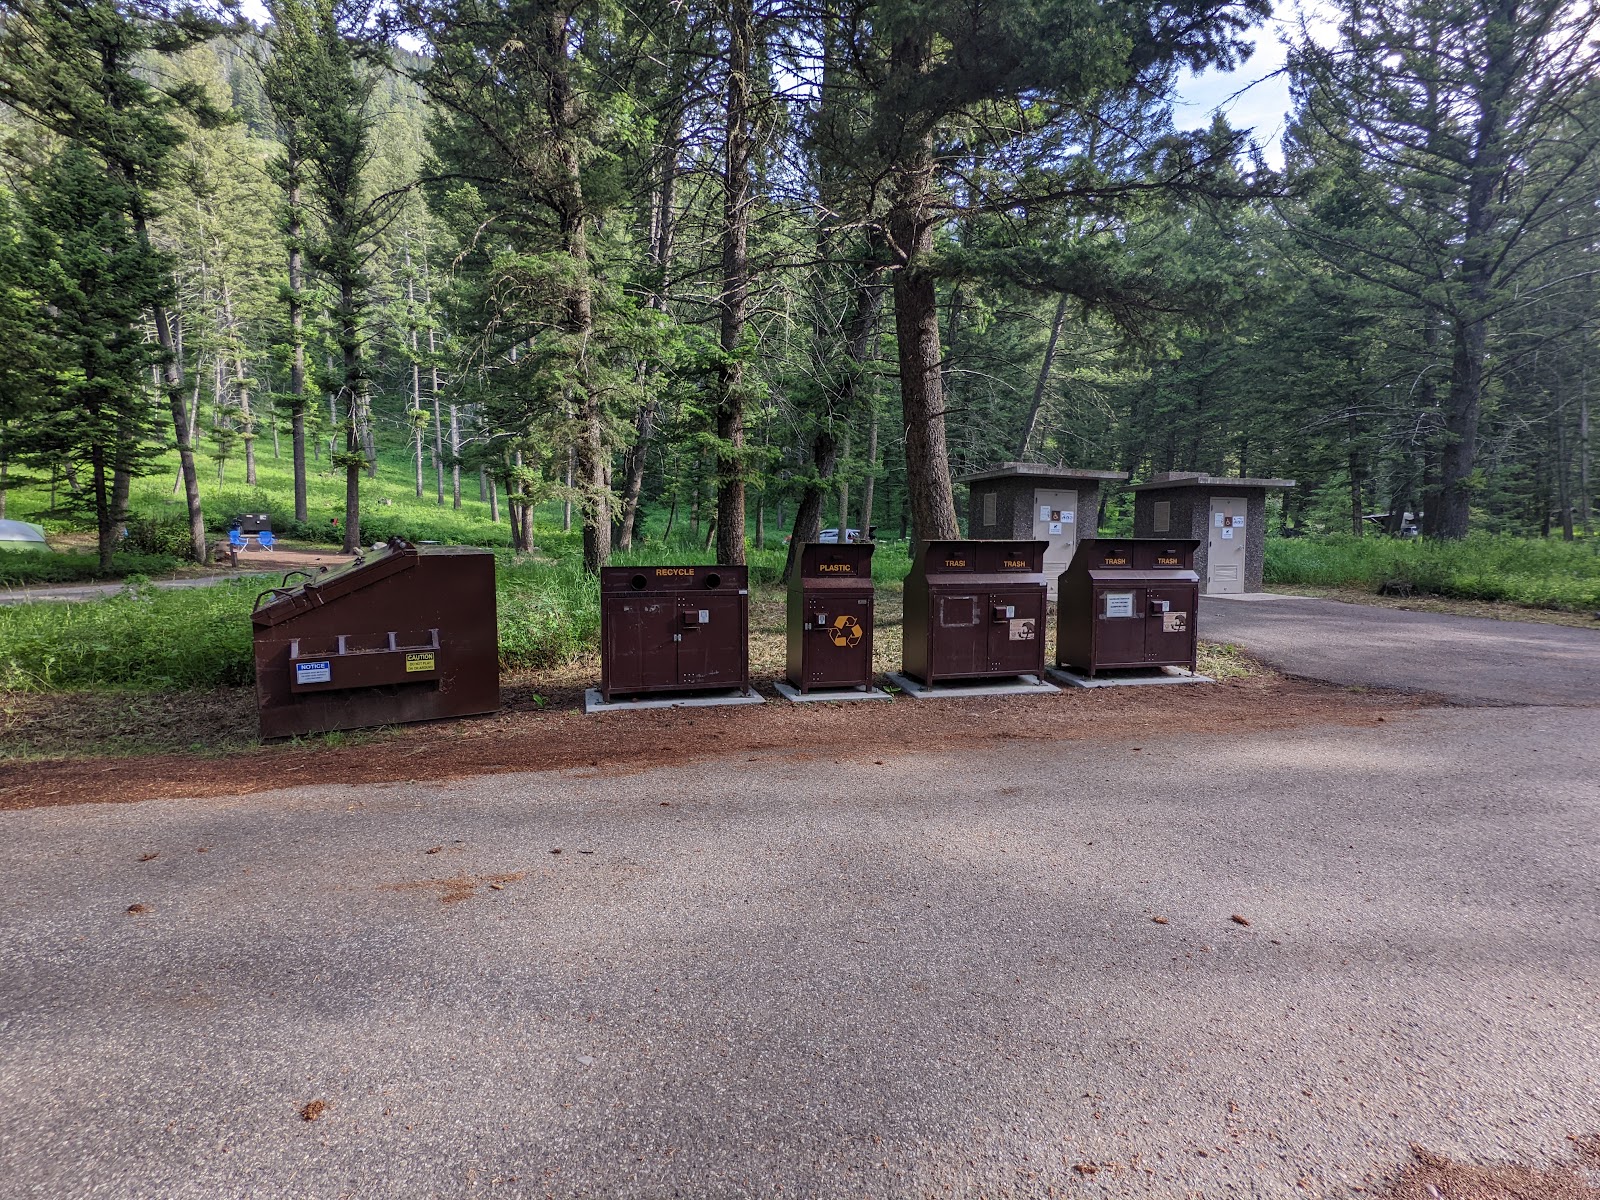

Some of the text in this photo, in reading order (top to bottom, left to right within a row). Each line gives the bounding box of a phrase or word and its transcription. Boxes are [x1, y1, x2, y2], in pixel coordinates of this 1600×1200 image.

[1157, 557, 1178, 565] TRASH
[655, 568, 695, 576] RECYCLE
[819, 564, 851, 572] PLASTIC
